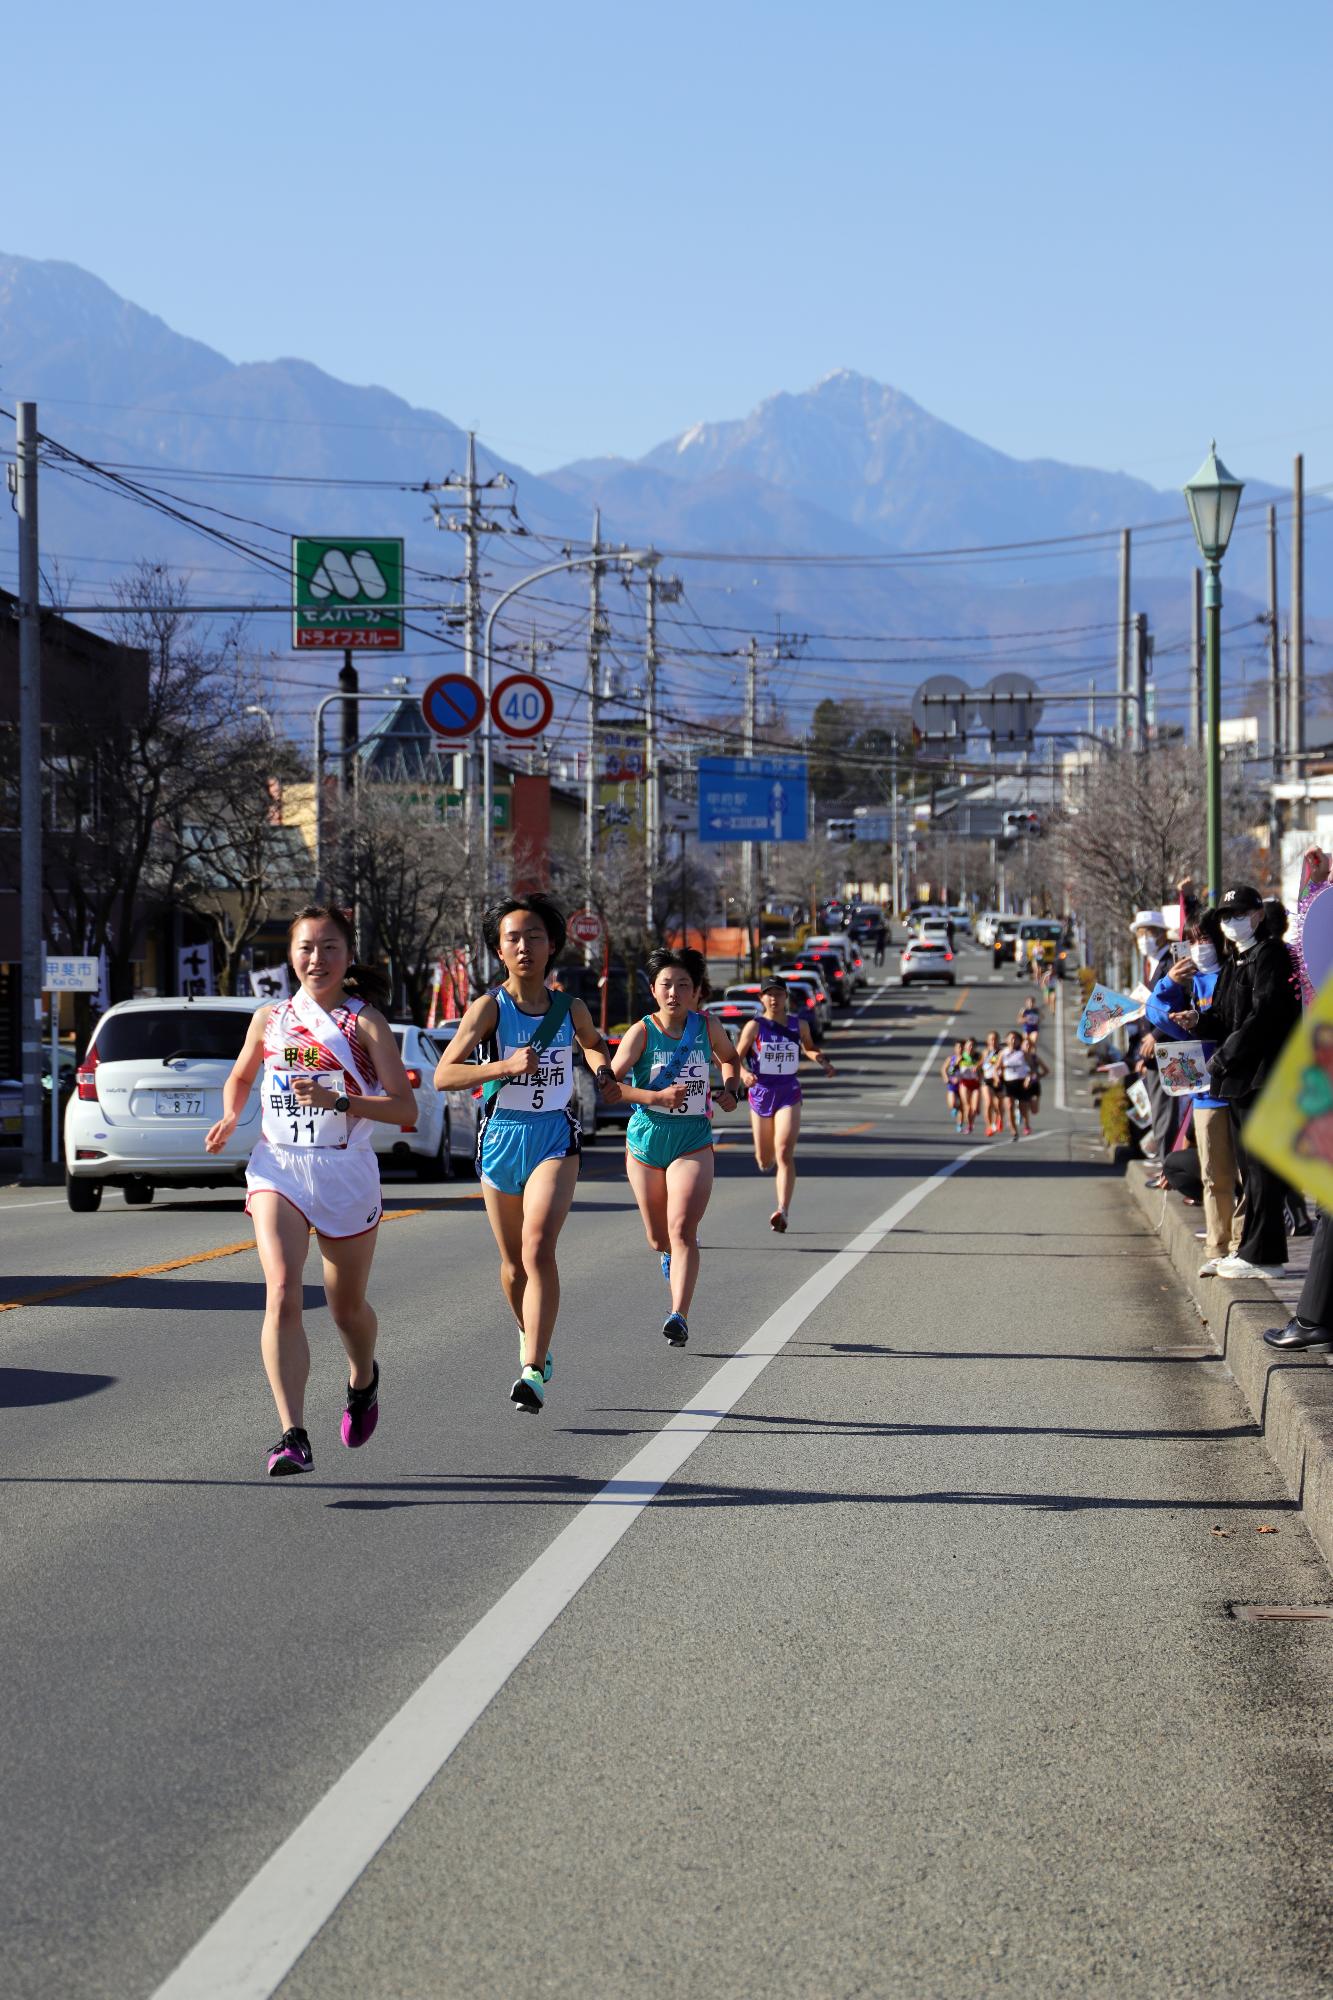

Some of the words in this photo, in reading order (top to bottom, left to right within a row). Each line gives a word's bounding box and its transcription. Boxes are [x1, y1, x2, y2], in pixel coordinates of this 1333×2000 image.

[505, 693, 540, 721] 40
[47, 962, 91, 976] 甲斐市
[284, 1047, 320, 1068] 甲斐
[765, 1052, 795, 1062] 甲府市
[777, 1063, 782, 1073] 1
[531, 1090, 544, 1110] 5
[290, 1120, 315, 1143] 11
